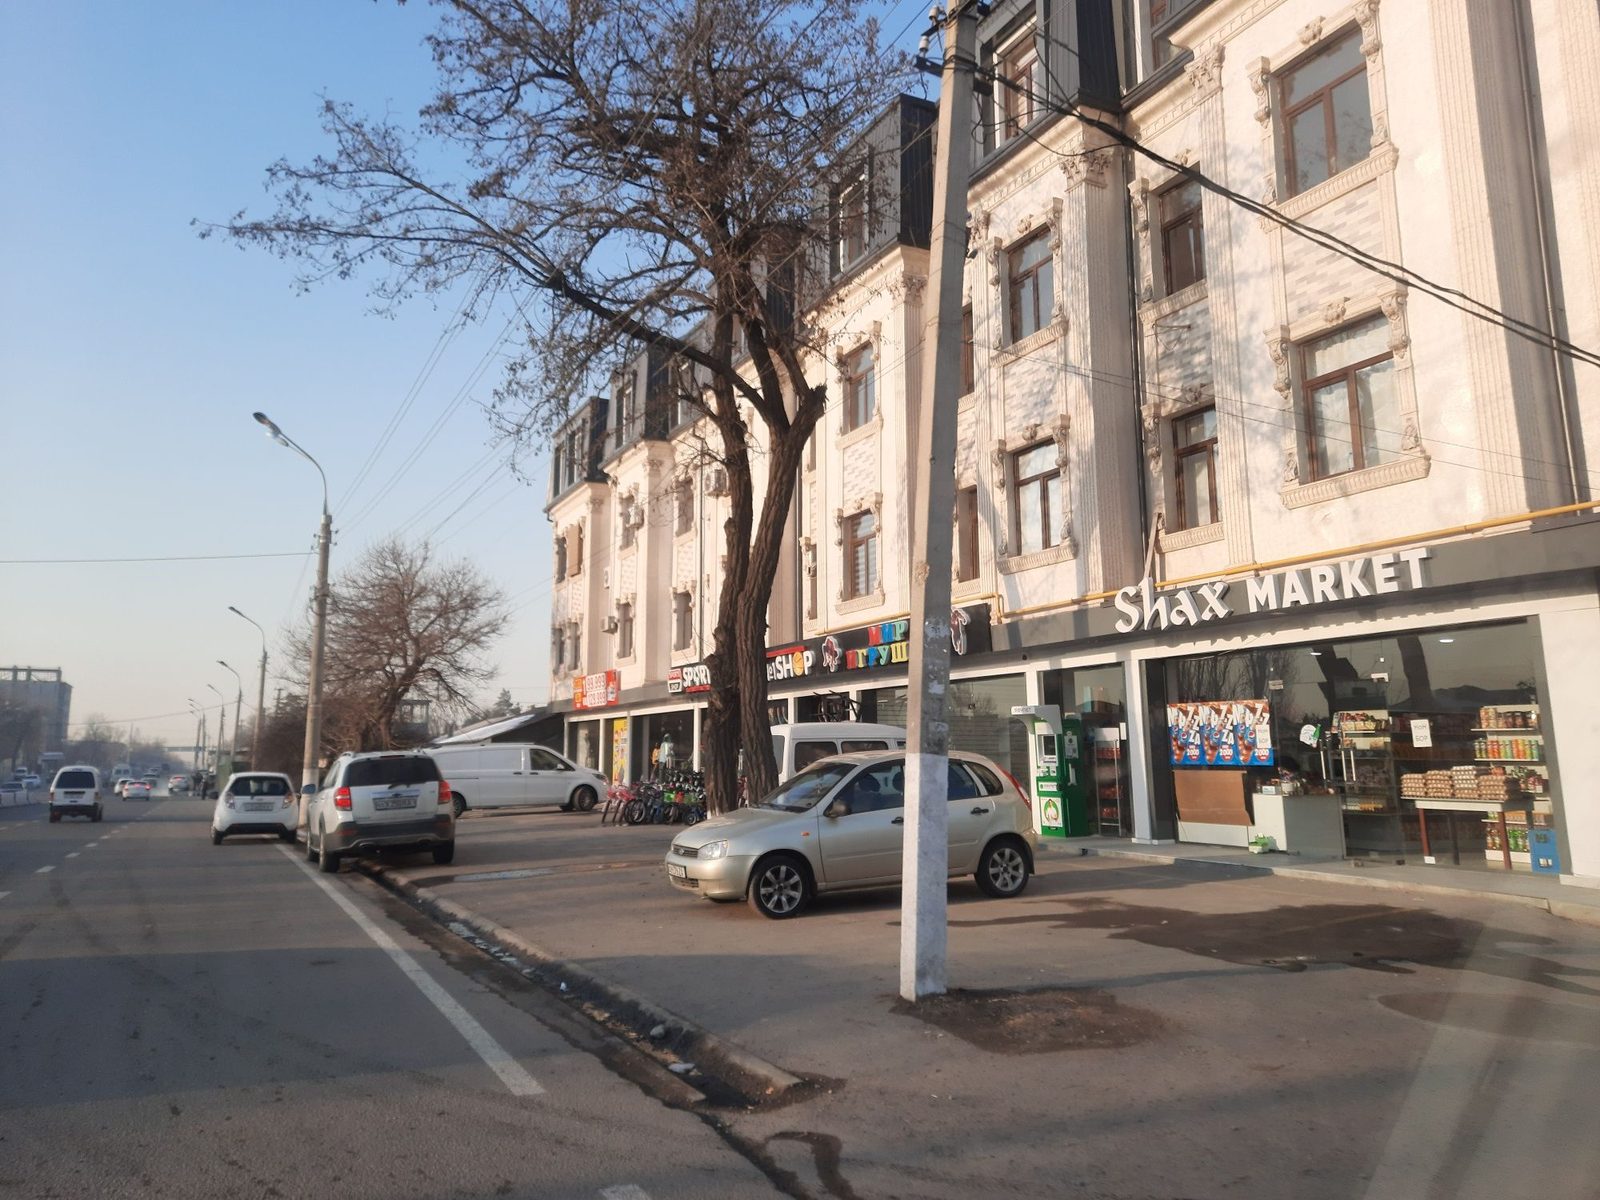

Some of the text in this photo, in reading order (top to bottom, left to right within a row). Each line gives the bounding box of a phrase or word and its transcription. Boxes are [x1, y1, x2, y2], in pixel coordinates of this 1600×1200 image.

[1114, 547, 1431, 633] Shax MARKET
[845, 641, 909, 670] ИГРУШ
